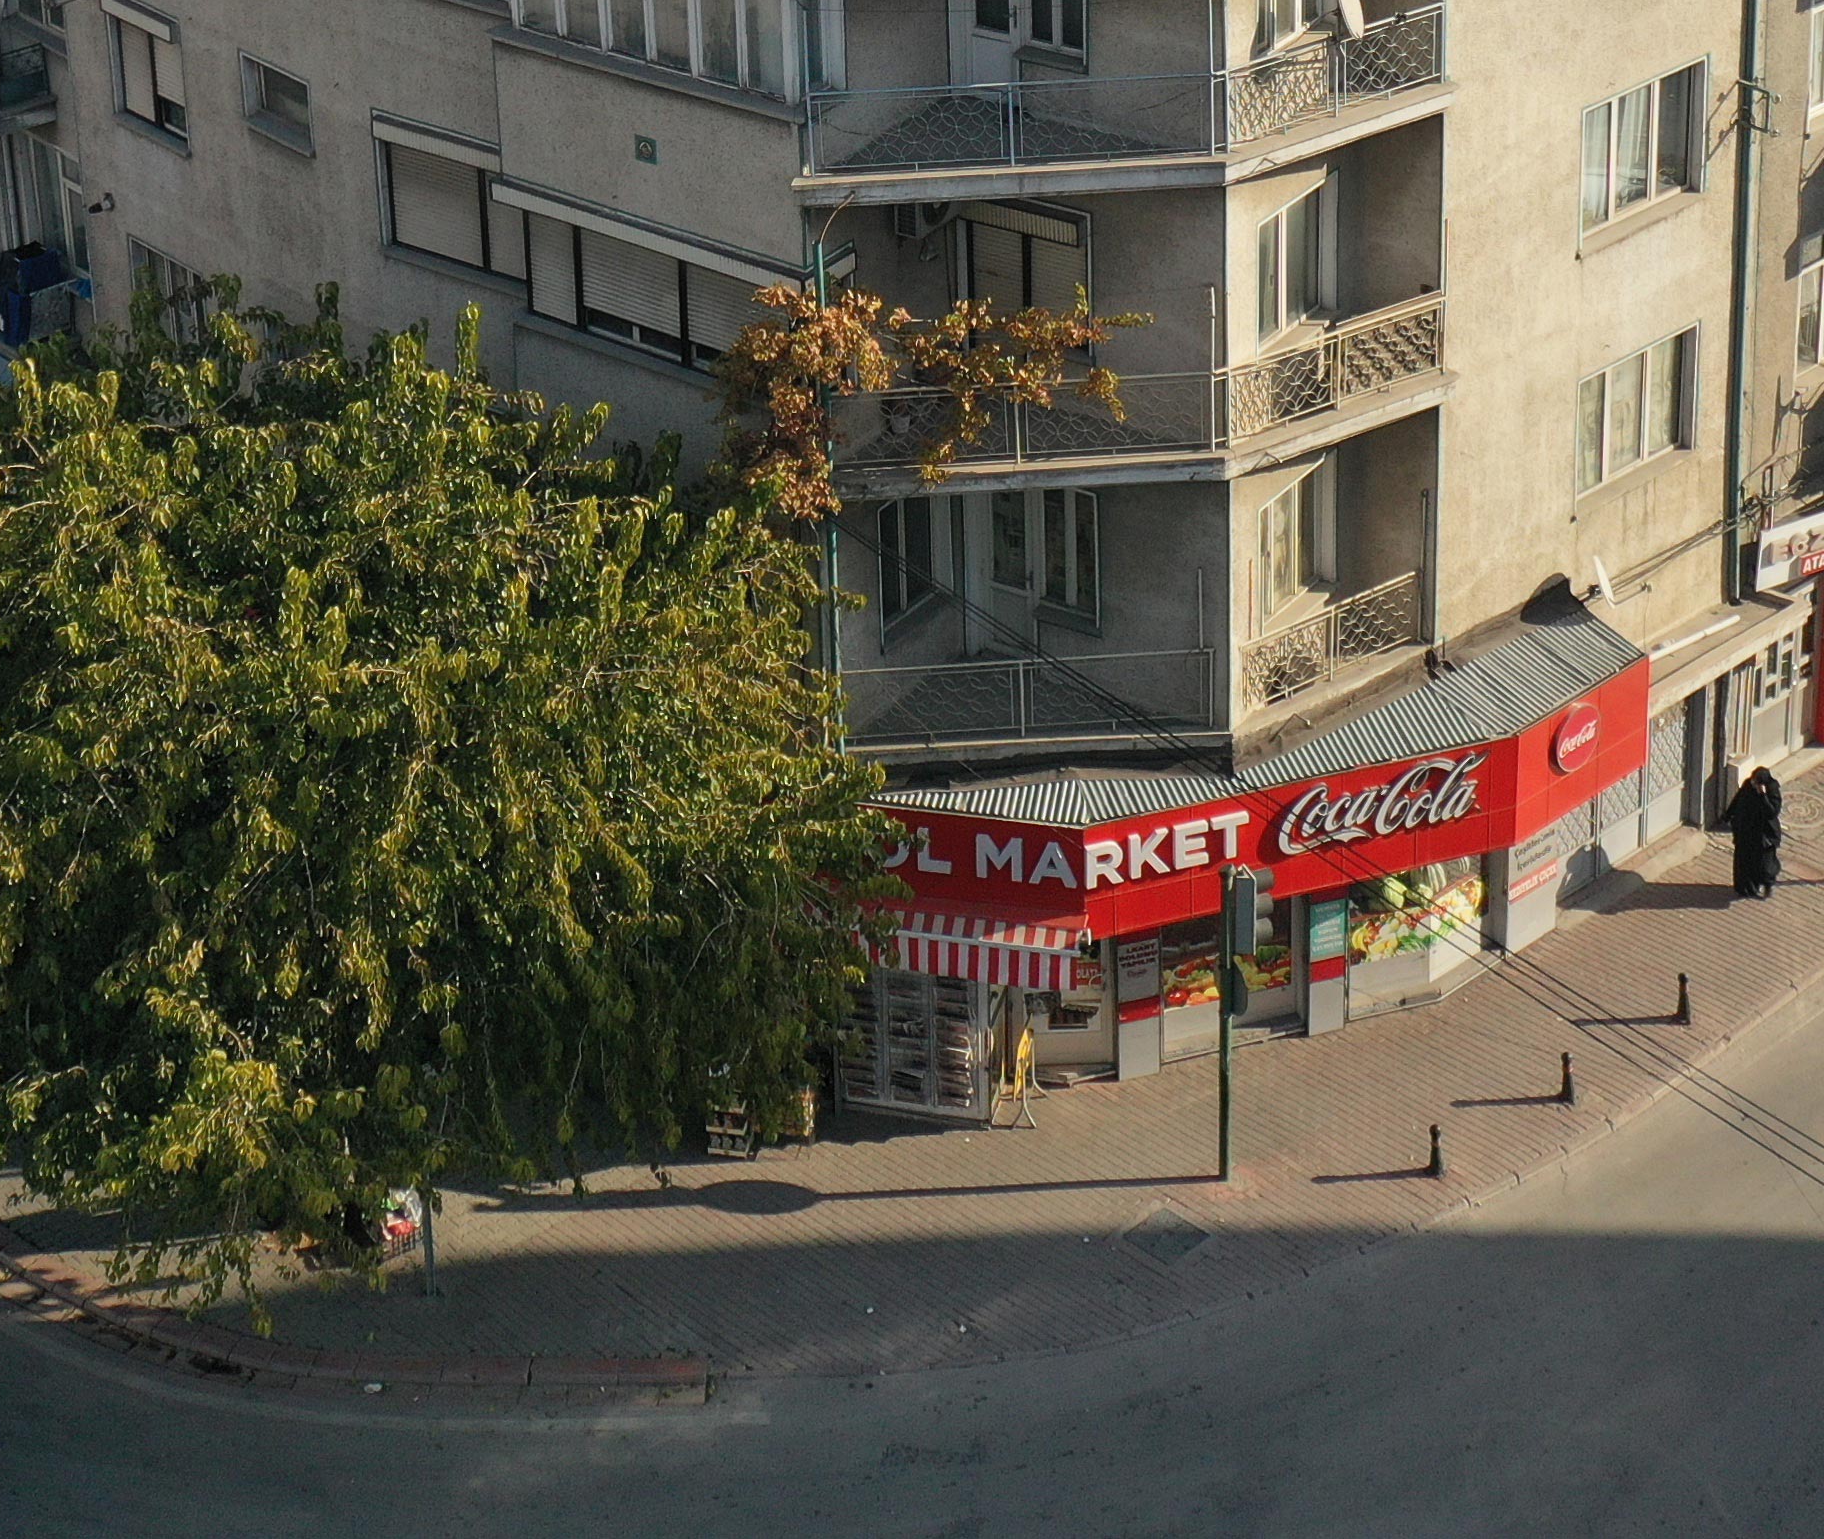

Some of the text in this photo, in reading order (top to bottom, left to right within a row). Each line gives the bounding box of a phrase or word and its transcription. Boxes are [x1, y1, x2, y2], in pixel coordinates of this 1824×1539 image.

[1559, 719, 1599, 759] Coca-Cola
[1278, 750, 1490, 856] Coca-Cola
[976, 810, 1250, 890] MARKET
